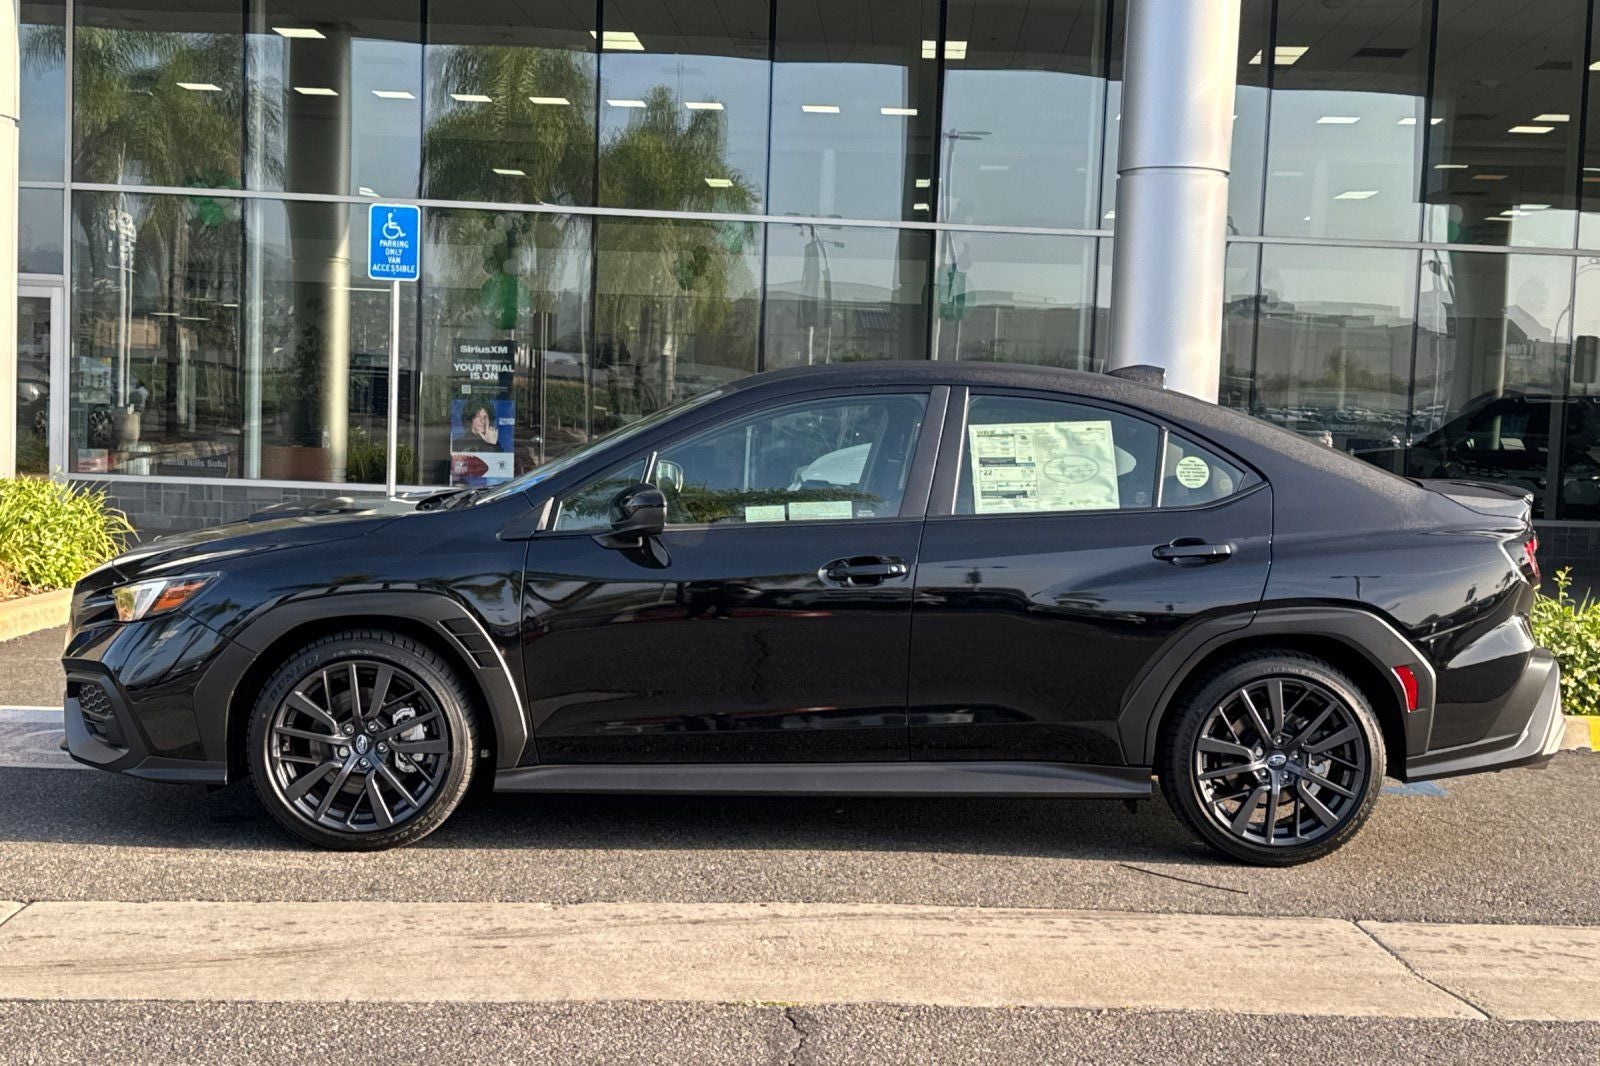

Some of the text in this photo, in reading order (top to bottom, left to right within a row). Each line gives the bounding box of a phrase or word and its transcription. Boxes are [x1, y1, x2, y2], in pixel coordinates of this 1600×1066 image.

[380, 239, 409, 248] PARKING
[385, 248, 403, 256] ONLY
[388, 256, 401, 264] VAN
[372, 263, 415, 273] ACCESSIBLE
[460, 345, 508, 354] SiriusXM
[453, 363, 515, 373] YOUR TRIAL
[470, 371, 499, 380] IS ON
